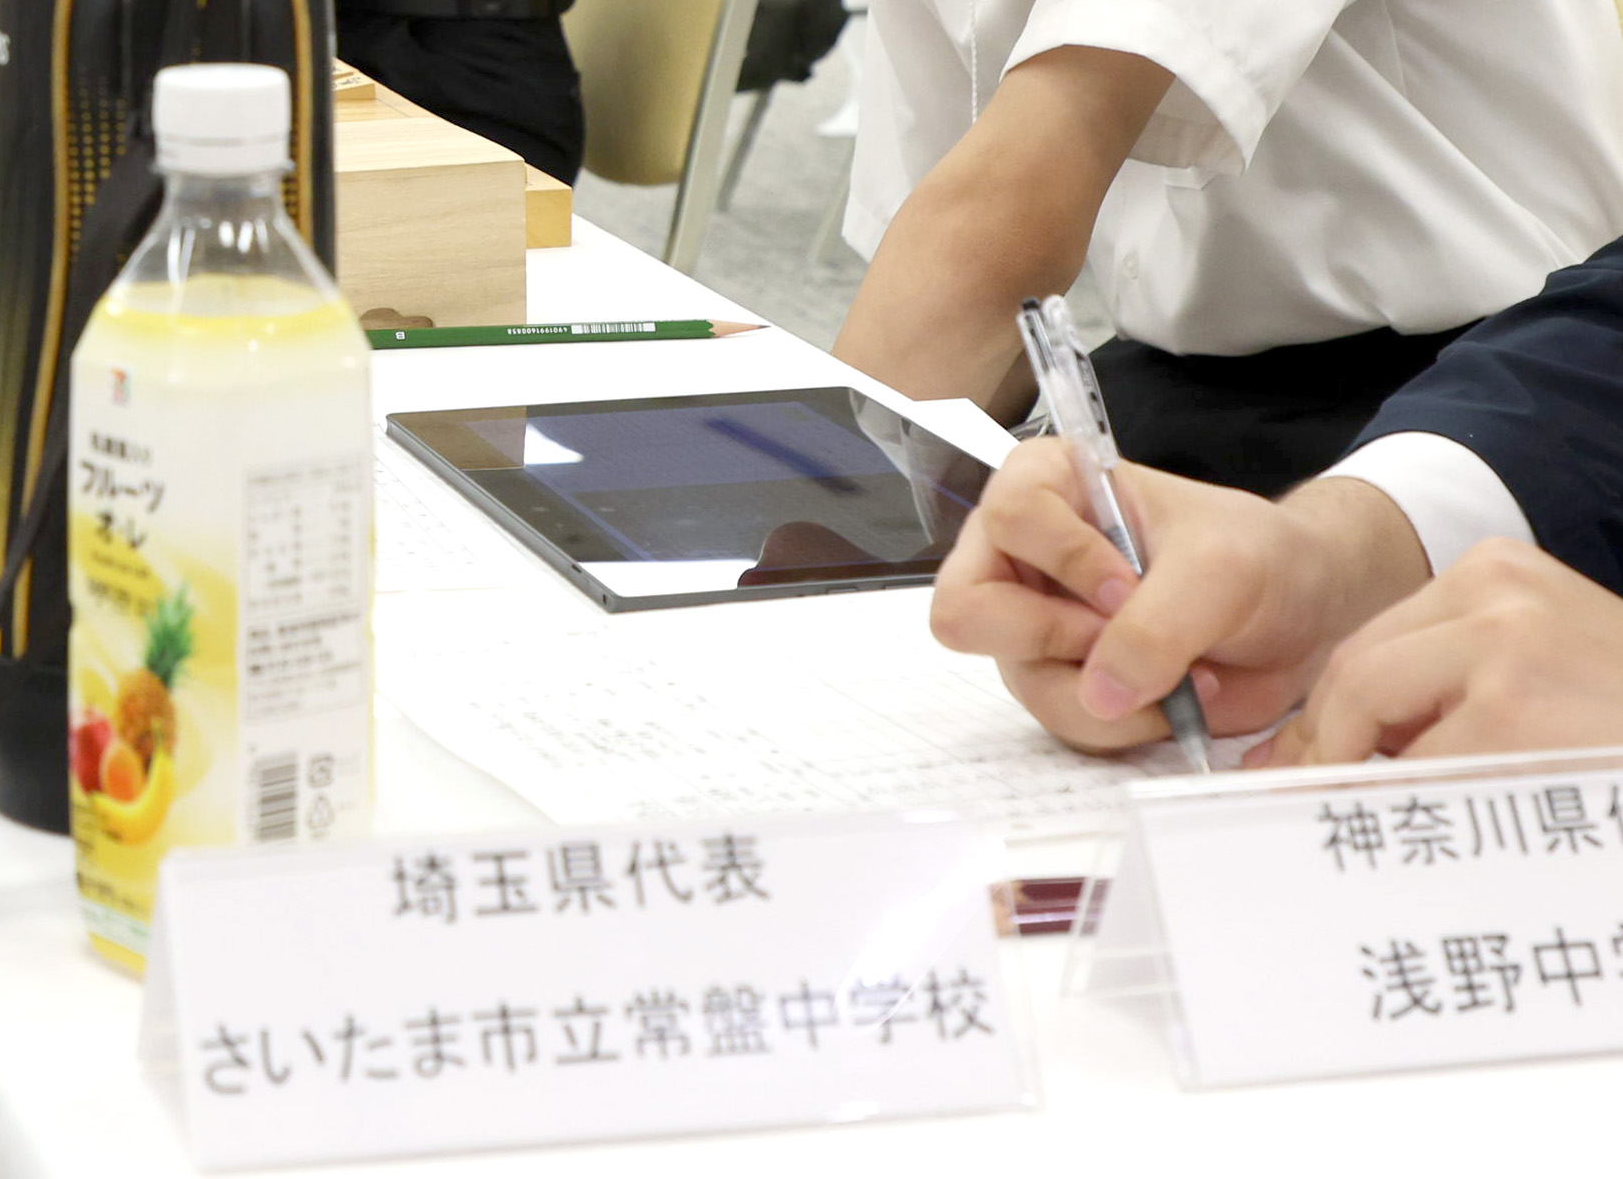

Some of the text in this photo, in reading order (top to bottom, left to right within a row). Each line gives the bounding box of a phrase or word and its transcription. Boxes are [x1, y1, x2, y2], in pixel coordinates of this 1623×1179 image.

[79, 458, 165, 514] フルーツ
[1317, 783, 1623, 871] 神奈川県
[390, 832, 772, 924] 埼玉県代表
[1359, 924, 1623, 1022] 浅野中
[197, 966, 996, 1096] さいたま市立常盤中学校
